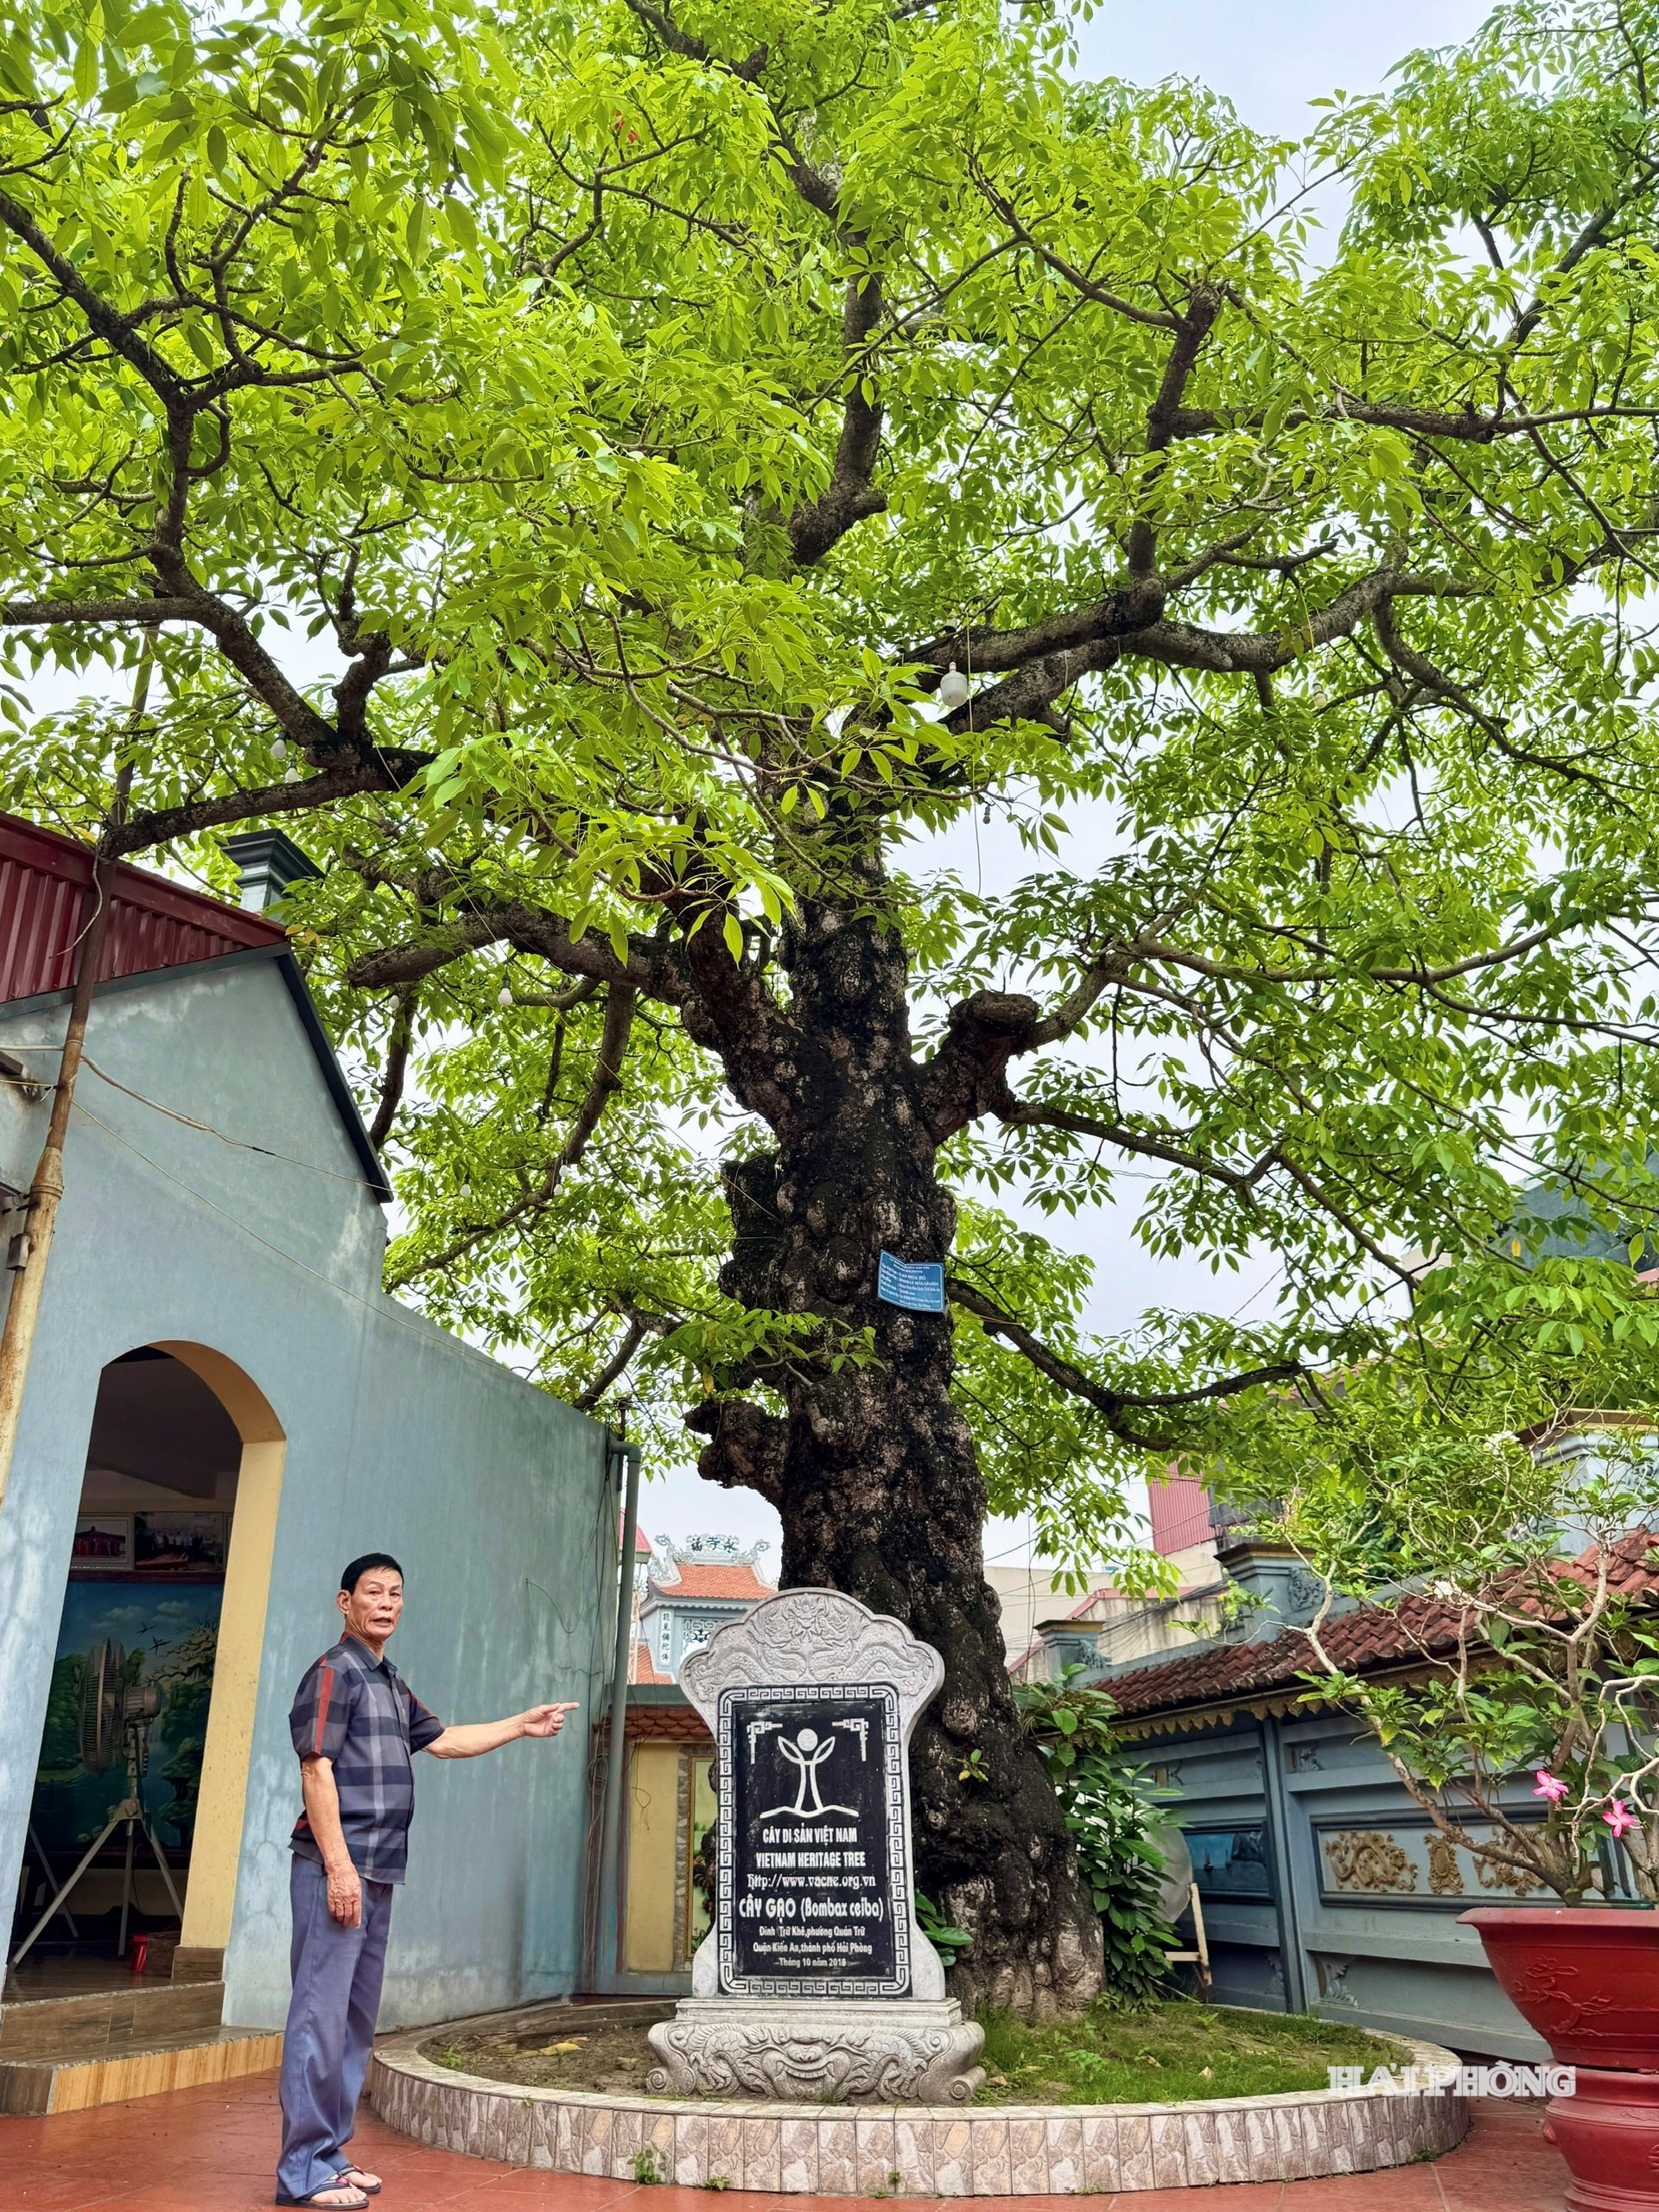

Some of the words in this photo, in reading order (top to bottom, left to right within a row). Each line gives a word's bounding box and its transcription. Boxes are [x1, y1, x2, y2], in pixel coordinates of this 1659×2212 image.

[762, 1825, 781, 1844] CÂY
[782, 1827, 792, 1843] DI
[793, 1821, 813, 1843] SẢN
[814, 1824, 834, 1846] VIỆT
[836, 1827, 858, 1843] NAM
[755, 1852, 796, 1868] VIETNAM
[798, 1851, 842, 1868] HERITAGE
[842, 1851, 867, 1867] TREE
[739, 1893, 762, 1917] CÂY
[765, 1897, 797, 1923] GẠO
[800, 1897, 848, 1923] (Bombax
[849, 1897, 884, 1923] ceiba)
[759, 1925, 776, 1936] Đình
[833, 1925, 853, 1936] Quán
[853, 1925, 866, 1936] Trữ
[753, 1942, 772, 1955] Quận
[772, 1940, 788, 1953] Kiến
[822, 1940, 836, 1955] phố
[836, 1941, 849, 1953] Hải
[849, 1942, 873, 1955] Phòng
[779, 1956, 801, 1968] Tháng
[803, 1957, 811, 1967] 10
[812, 1957, 828, 1967] năm
